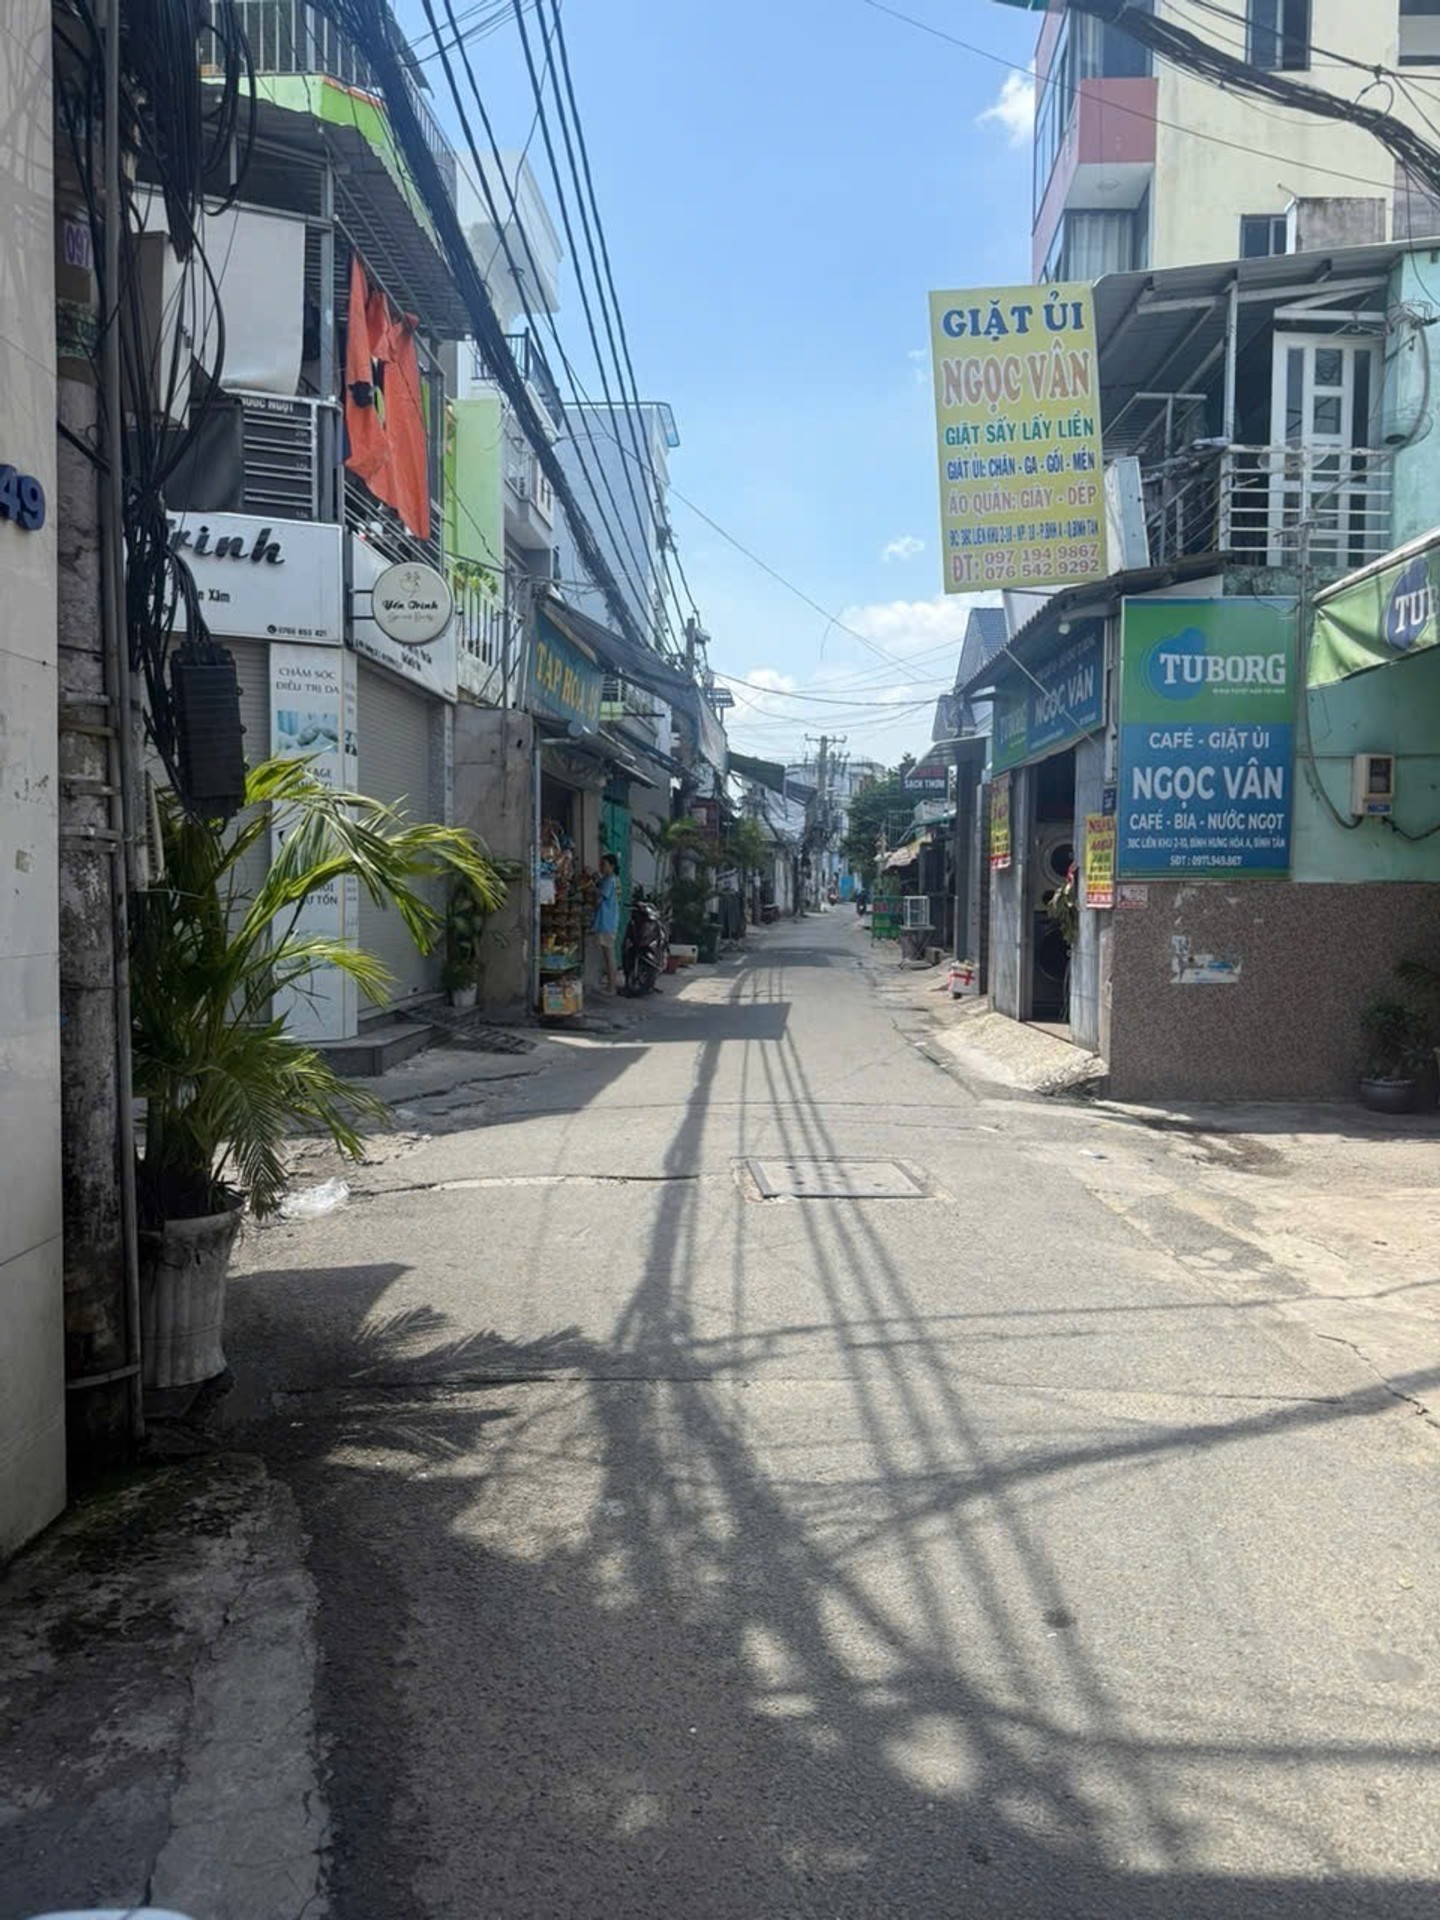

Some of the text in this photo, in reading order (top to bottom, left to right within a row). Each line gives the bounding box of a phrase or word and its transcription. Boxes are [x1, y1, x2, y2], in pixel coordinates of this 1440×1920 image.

[942, 290, 1085, 342] GIẶT ỦI
[941, 340, 1091, 413] NGỌC VÂN
[945, 422, 980, 450] GIẶT
[986, 416, 1017, 443] SẤY
[1022, 413, 1052, 440] LẤY
[1024, 456, 1039, 475] GA
[1046, 446, 1064, 473] GỐI
[1067, 480, 1096, 505] DÉP
[165, 518, 285, 565] rinh
[985, 551, 1015, 566] 097
[1022, 548, 1052, 562] 194
[1057, 544, 1098, 560] 9867
[985, 560, 1100, 580] 076 542 9292
[1159, 653, 1286, 685] TUBORG
[1068, 663, 1094, 709] VÂN
[1149, 726, 1270, 753] CAFÉ GIẶT ỦI
[1132, 766, 1215, 808] NGỌC
[1223, 757, 1284, 800] VÂN
[1129, 808, 1285, 834] CAFÉ BIA NƯỚC NGỌT
